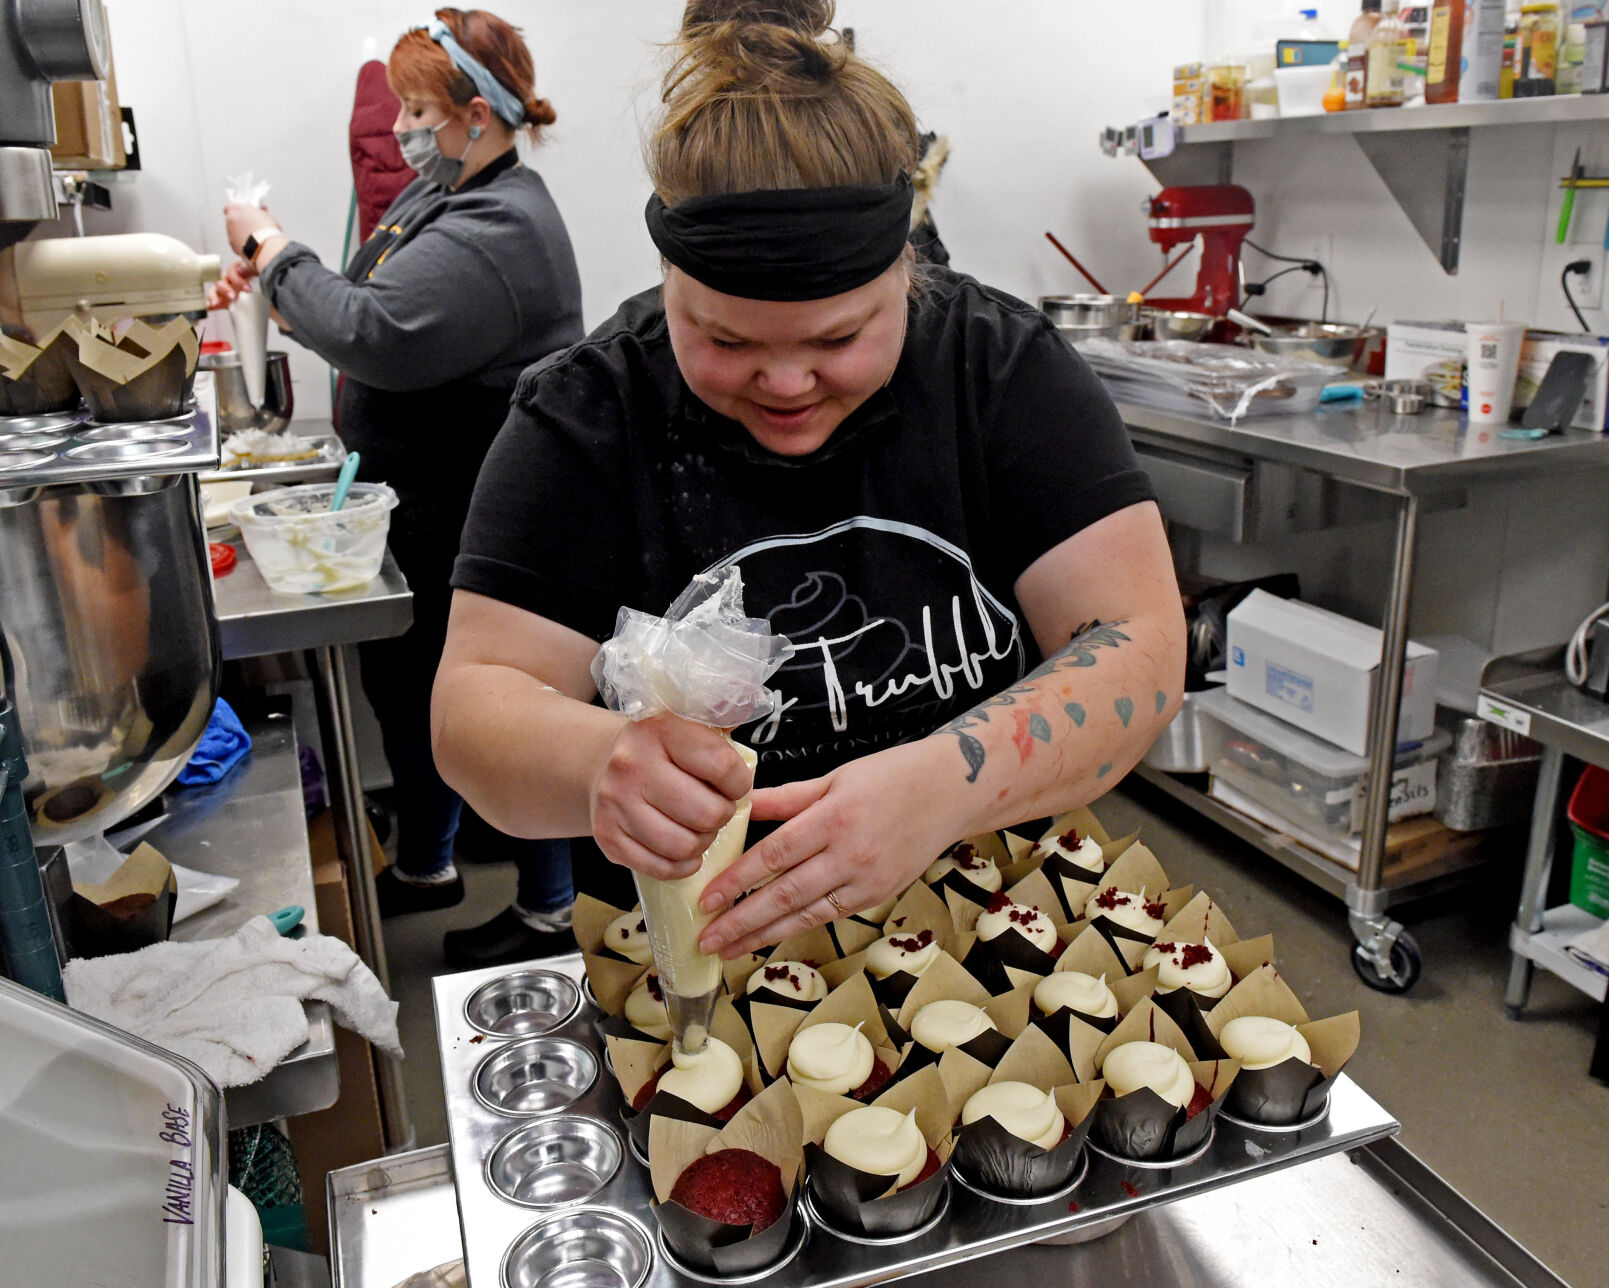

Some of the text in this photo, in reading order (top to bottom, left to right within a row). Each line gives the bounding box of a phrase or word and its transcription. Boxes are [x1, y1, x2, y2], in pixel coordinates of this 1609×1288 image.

[782, 578, 1017, 732] Trubbl
[158, 1102, 195, 1225] VANILLA BASE
